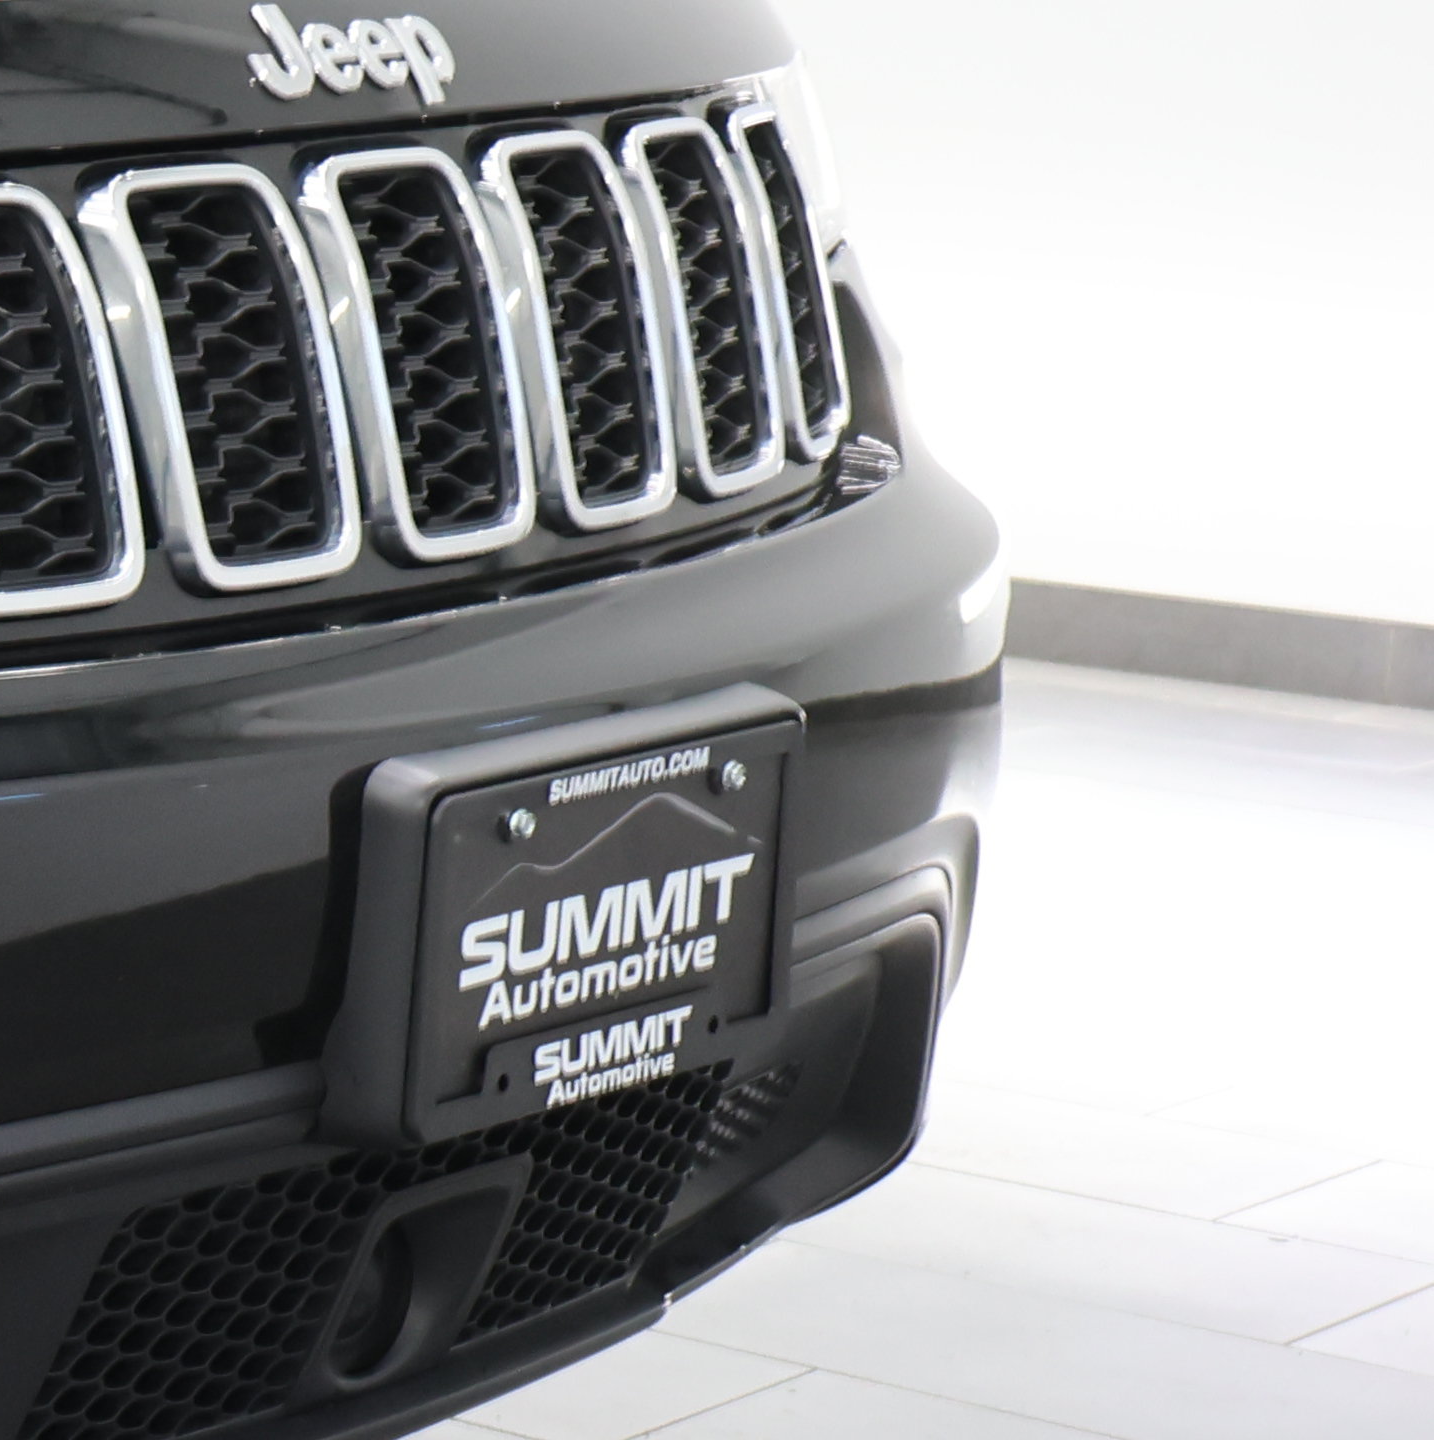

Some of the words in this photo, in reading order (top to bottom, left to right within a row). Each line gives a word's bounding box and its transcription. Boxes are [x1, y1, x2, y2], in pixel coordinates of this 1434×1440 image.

[247, 3, 456, 106] Jeep
[548, 746, 711, 806] SUMMITAUTO.COM
[459, 853, 755, 992] SUMMIT
[477, 933, 718, 1032] Automotive
[533, 1004, 693, 1088] SUMMIT
[546, 1051, 676, 1110] Automotive
